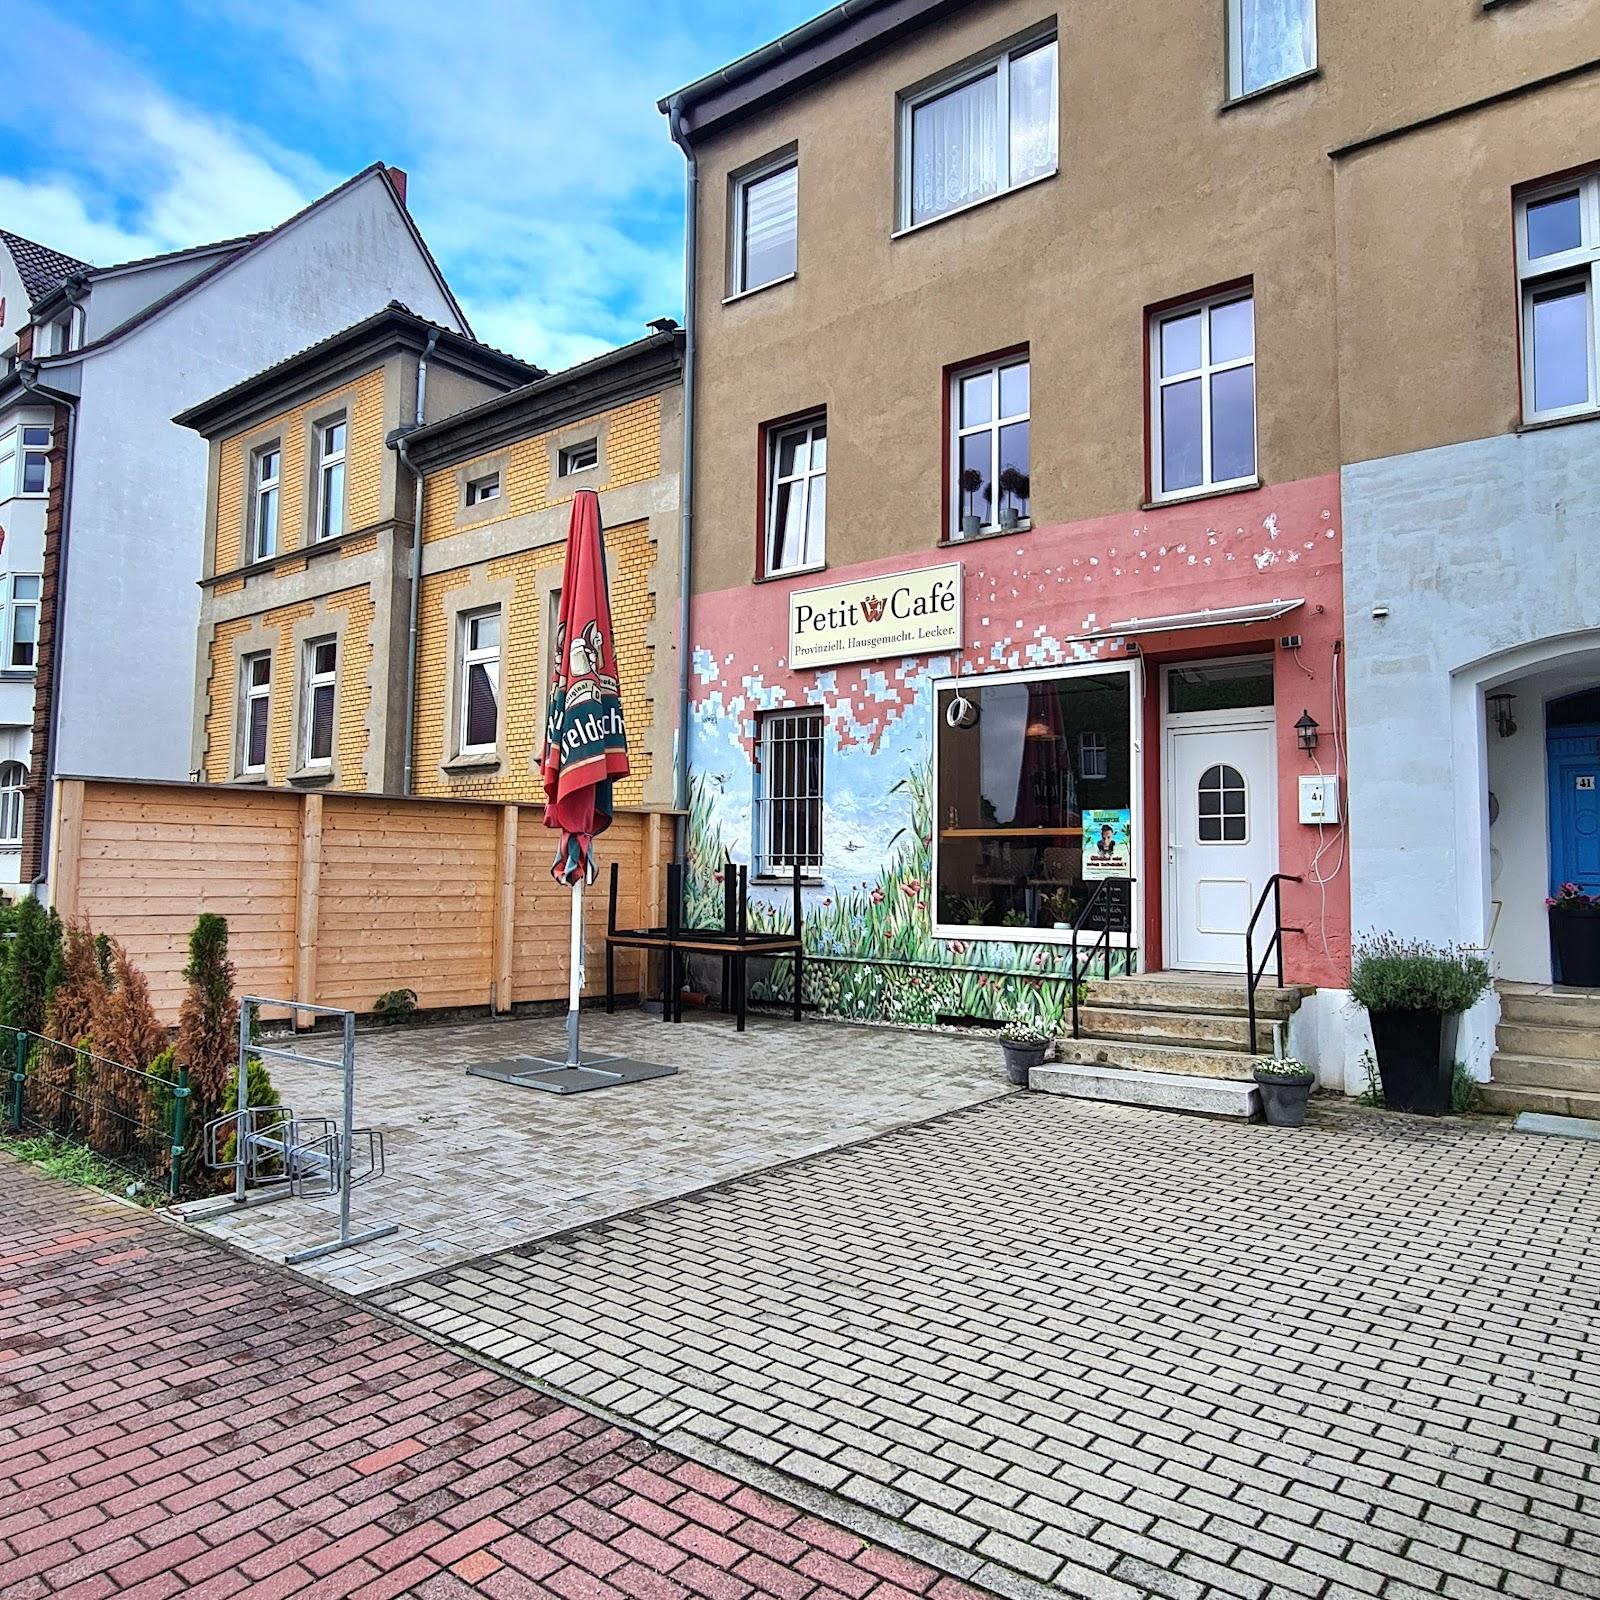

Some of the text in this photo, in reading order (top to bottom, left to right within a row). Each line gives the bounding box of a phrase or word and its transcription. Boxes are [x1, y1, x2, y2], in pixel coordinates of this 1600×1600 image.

[794, 600, 859, 634] Petit
[891, 580, 955, 619] Café
[794, 625, 955, 656] Provinziell. Hausgemacht. Lecker.
[560, 707, 625, 765] eldsch
[1579, 778, 1591, 788] 41
